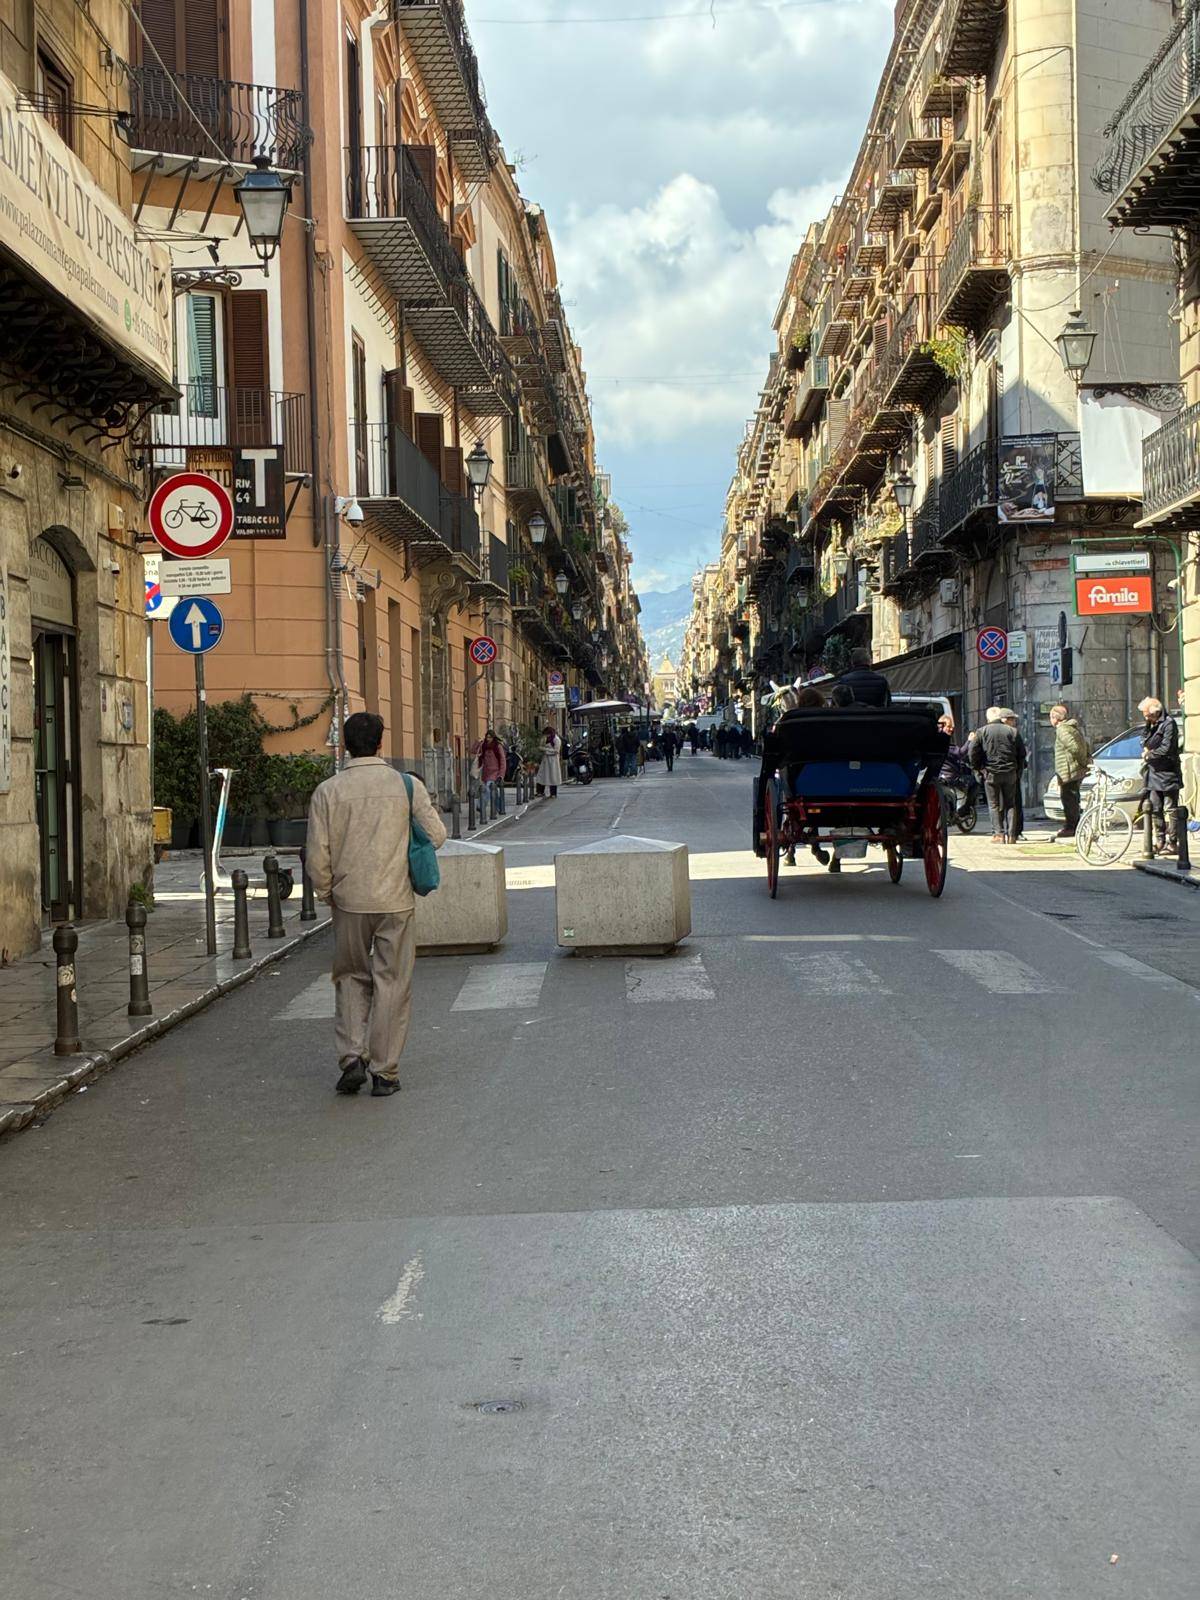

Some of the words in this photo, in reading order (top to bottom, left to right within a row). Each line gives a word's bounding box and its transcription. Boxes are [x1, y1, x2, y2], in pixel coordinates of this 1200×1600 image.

[73, 182, 93, 250] DI
[235, 478, 252, 489] RIV.
[241, 448, 278, 507] T
[235, 491, 251, 504] 64
[236, 515, 280, 525] TABACCHI
[1088, 585, 1138, 607] famila
